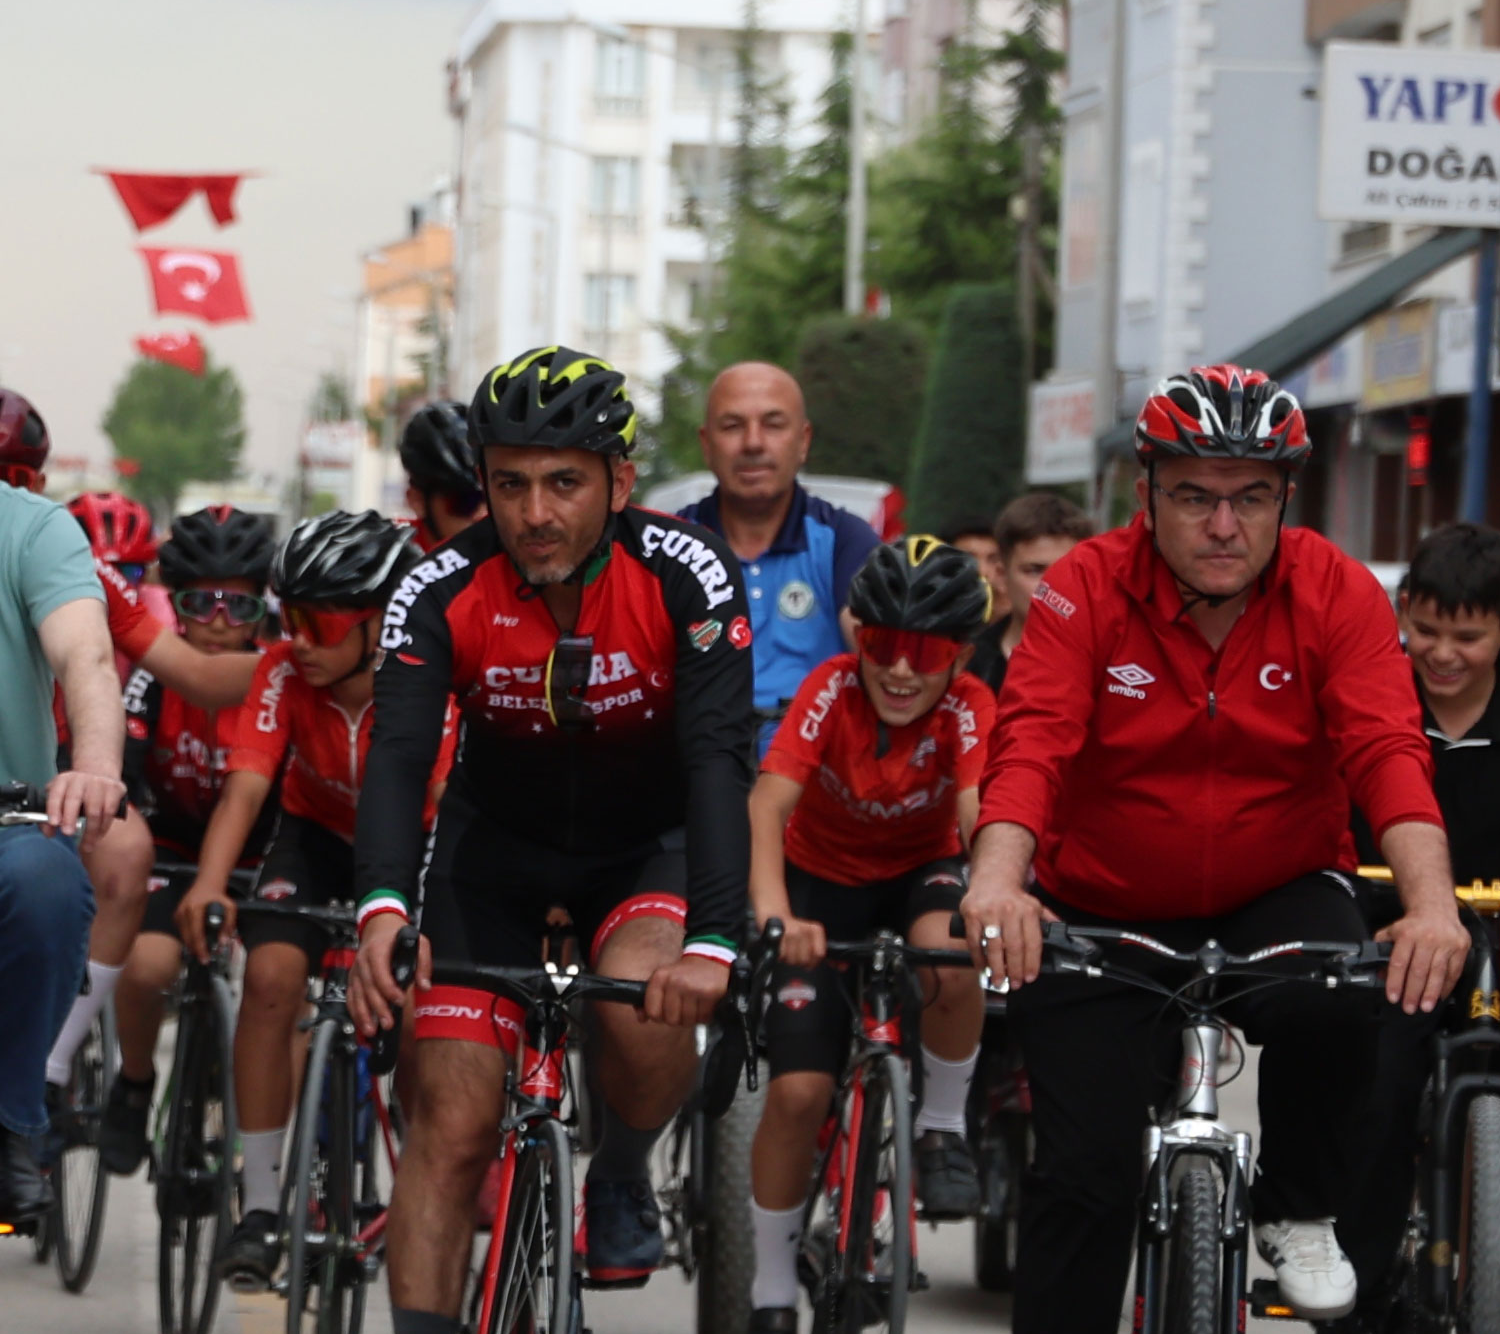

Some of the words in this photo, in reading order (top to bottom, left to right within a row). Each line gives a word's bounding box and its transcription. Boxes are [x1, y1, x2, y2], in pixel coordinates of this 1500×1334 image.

[1357, 75, 1489, 126] YAPI
[640, 523, 735, 611] ÇUMRA
[379, 548, 470, 649] ÇUMRA
[485, 651, 639, 692] ÇURA
[1107, 683, 1147, 701] umbro
[487, 687, 645, 715] BELEDSPOR
